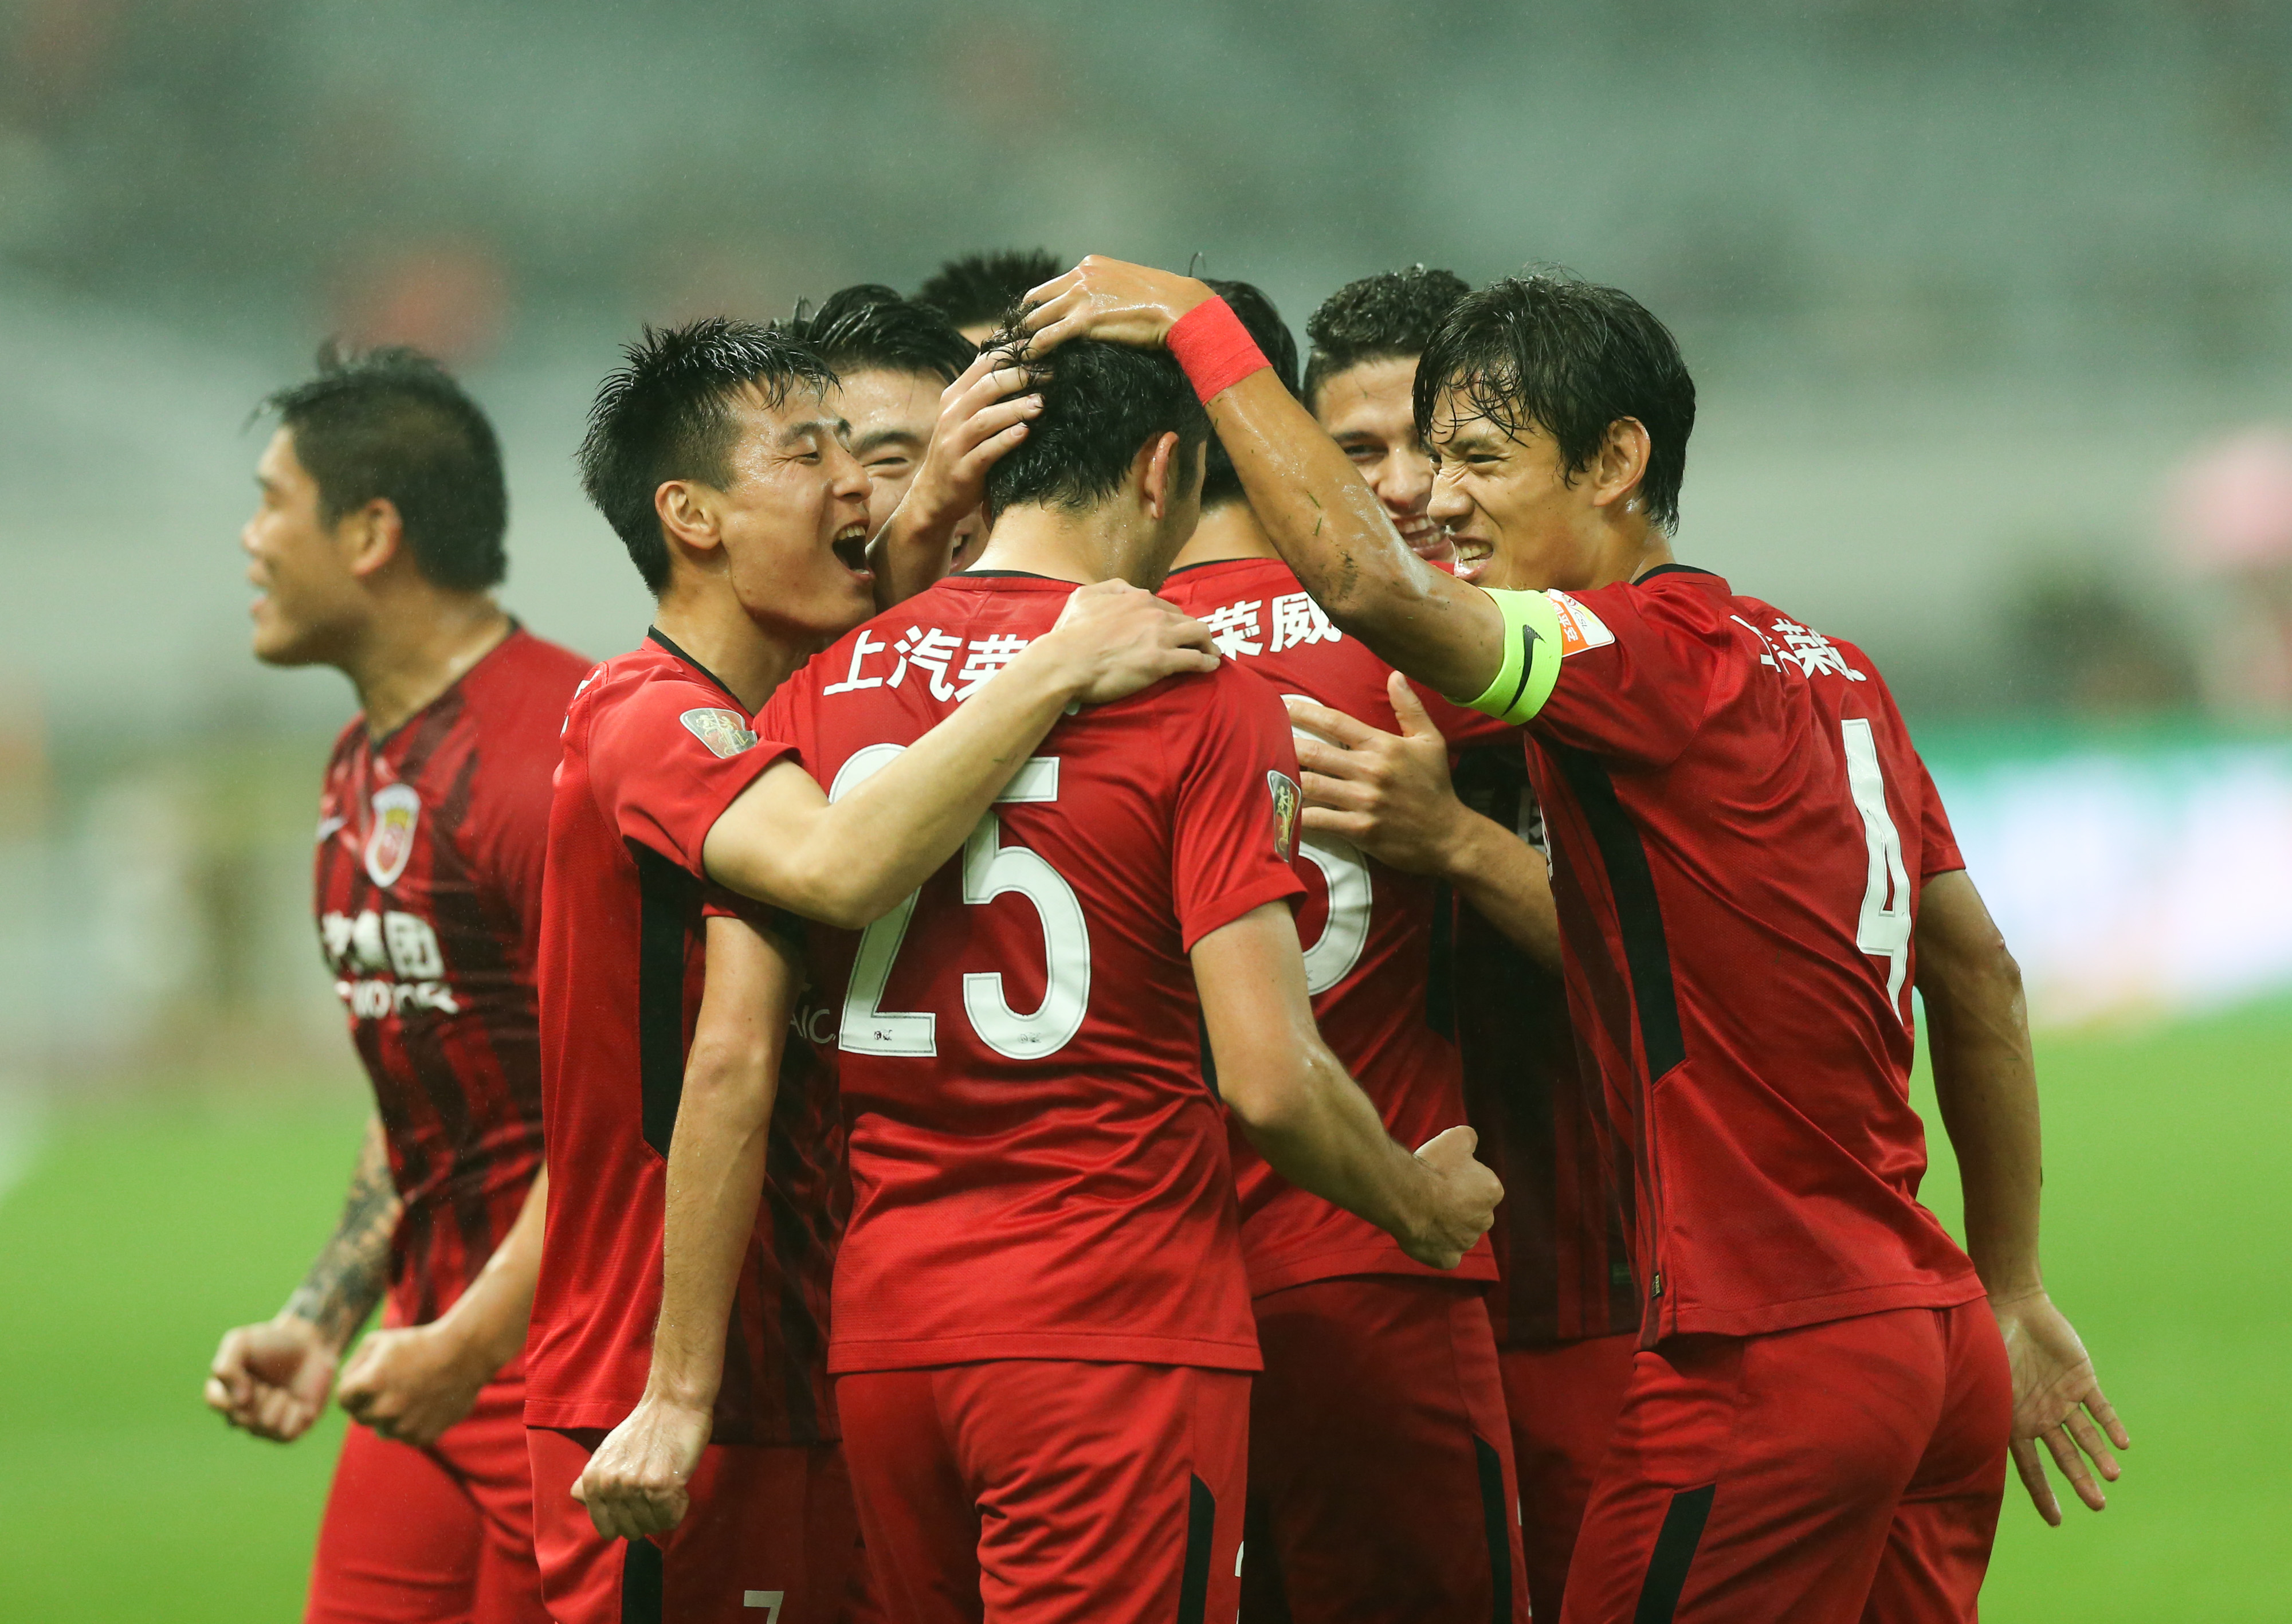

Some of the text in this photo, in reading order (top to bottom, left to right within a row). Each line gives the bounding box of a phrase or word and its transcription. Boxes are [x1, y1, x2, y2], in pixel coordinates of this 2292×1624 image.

[1544, 597, 1579, 642] 国平安
[1574, 611, 1588, 630] CSL
[823, 625, 1082, 716] 上汽荣
[829, 743, 1092, 1060] 25
[1841, 718, 1912, 1027] 4
